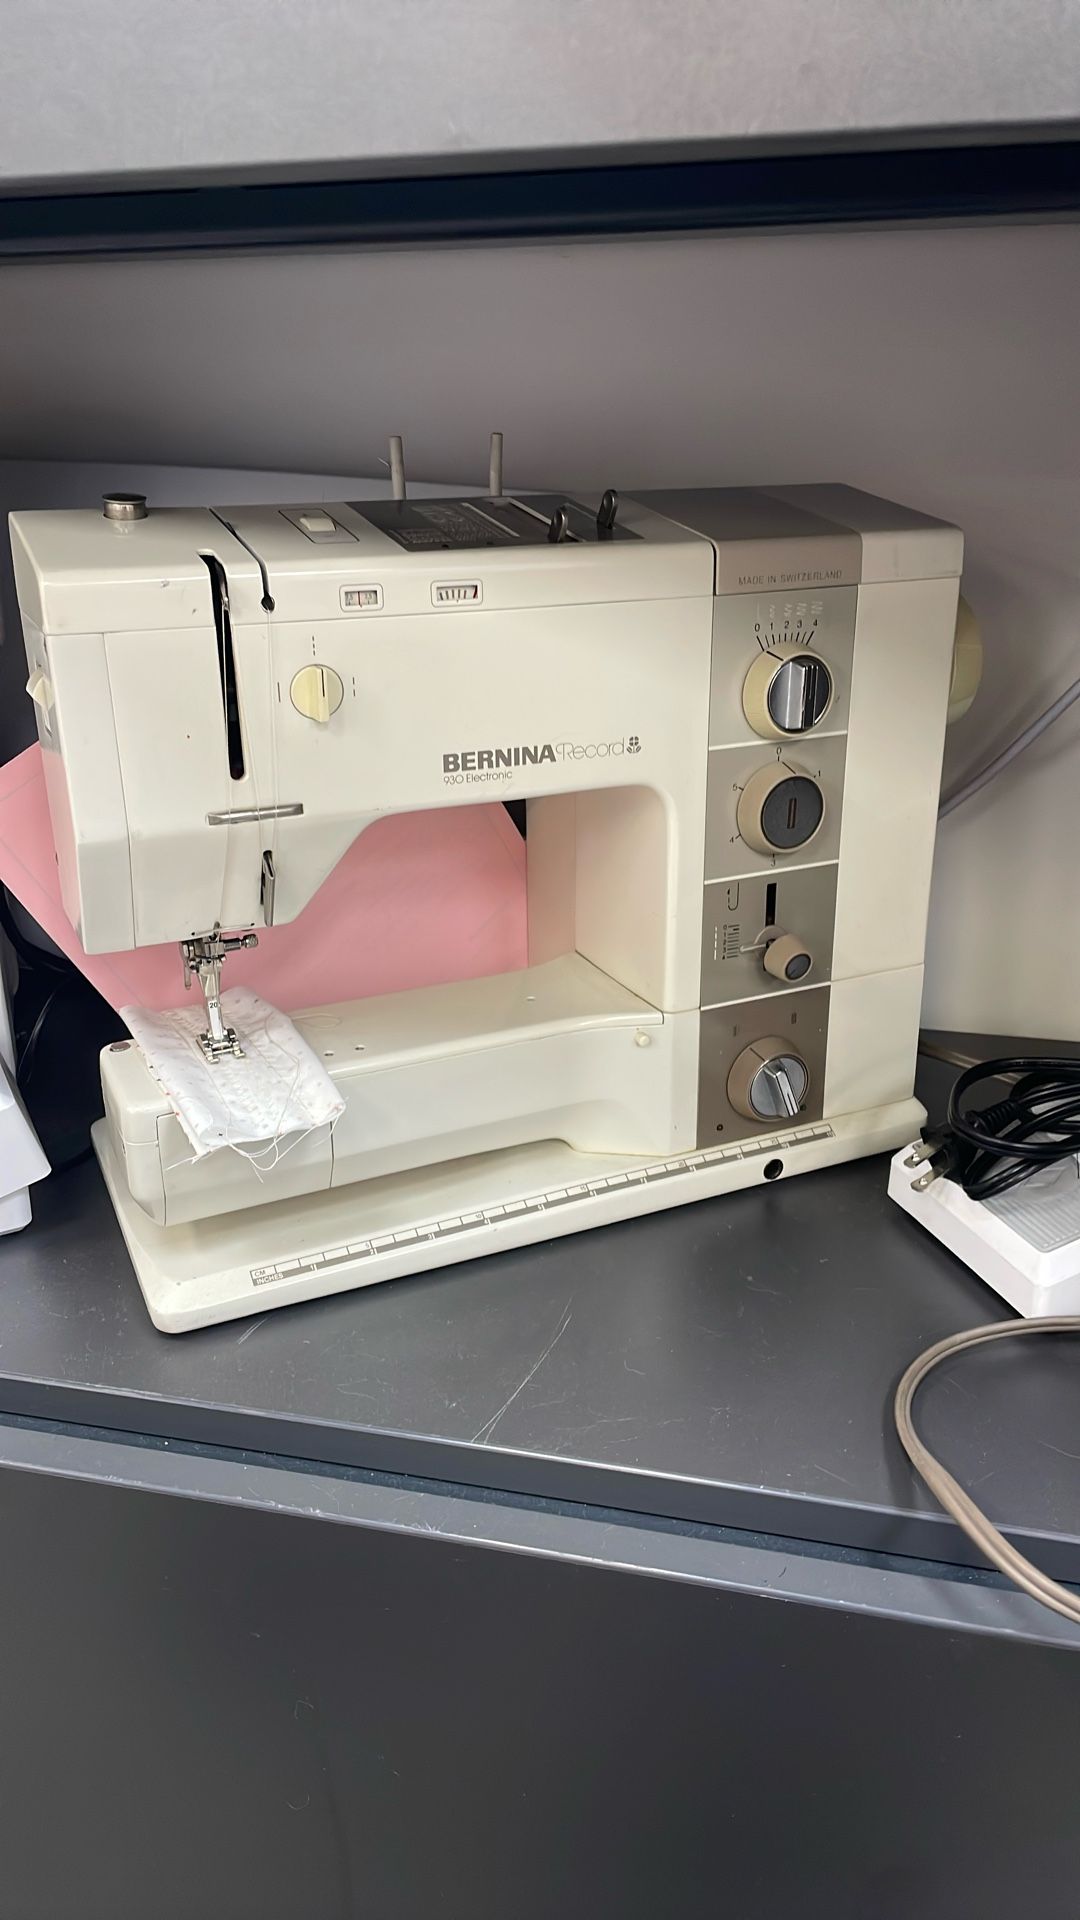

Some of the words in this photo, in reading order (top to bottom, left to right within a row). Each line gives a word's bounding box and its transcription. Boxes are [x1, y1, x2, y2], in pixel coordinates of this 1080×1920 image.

[739, 576, 764, 585] MADE
[768, 575, 776, 584] IN
[780, 570, 842, 583] SWITZERLAND
[754, 623, 760, 632] 0
[784, 620, 790, 629] 2
[797, 620, 802, 628] 3
[812, 619, 818, 627] 4
[443, 744, 556, 773] BERNINA
[556, 737, 624, 761] Record
[776, 746, 782, 755] 0
[444, 774, 464, 786] 930
[466, 770, 512, 784] Electronic
[256, 1273, 284, 1285] INCHES
